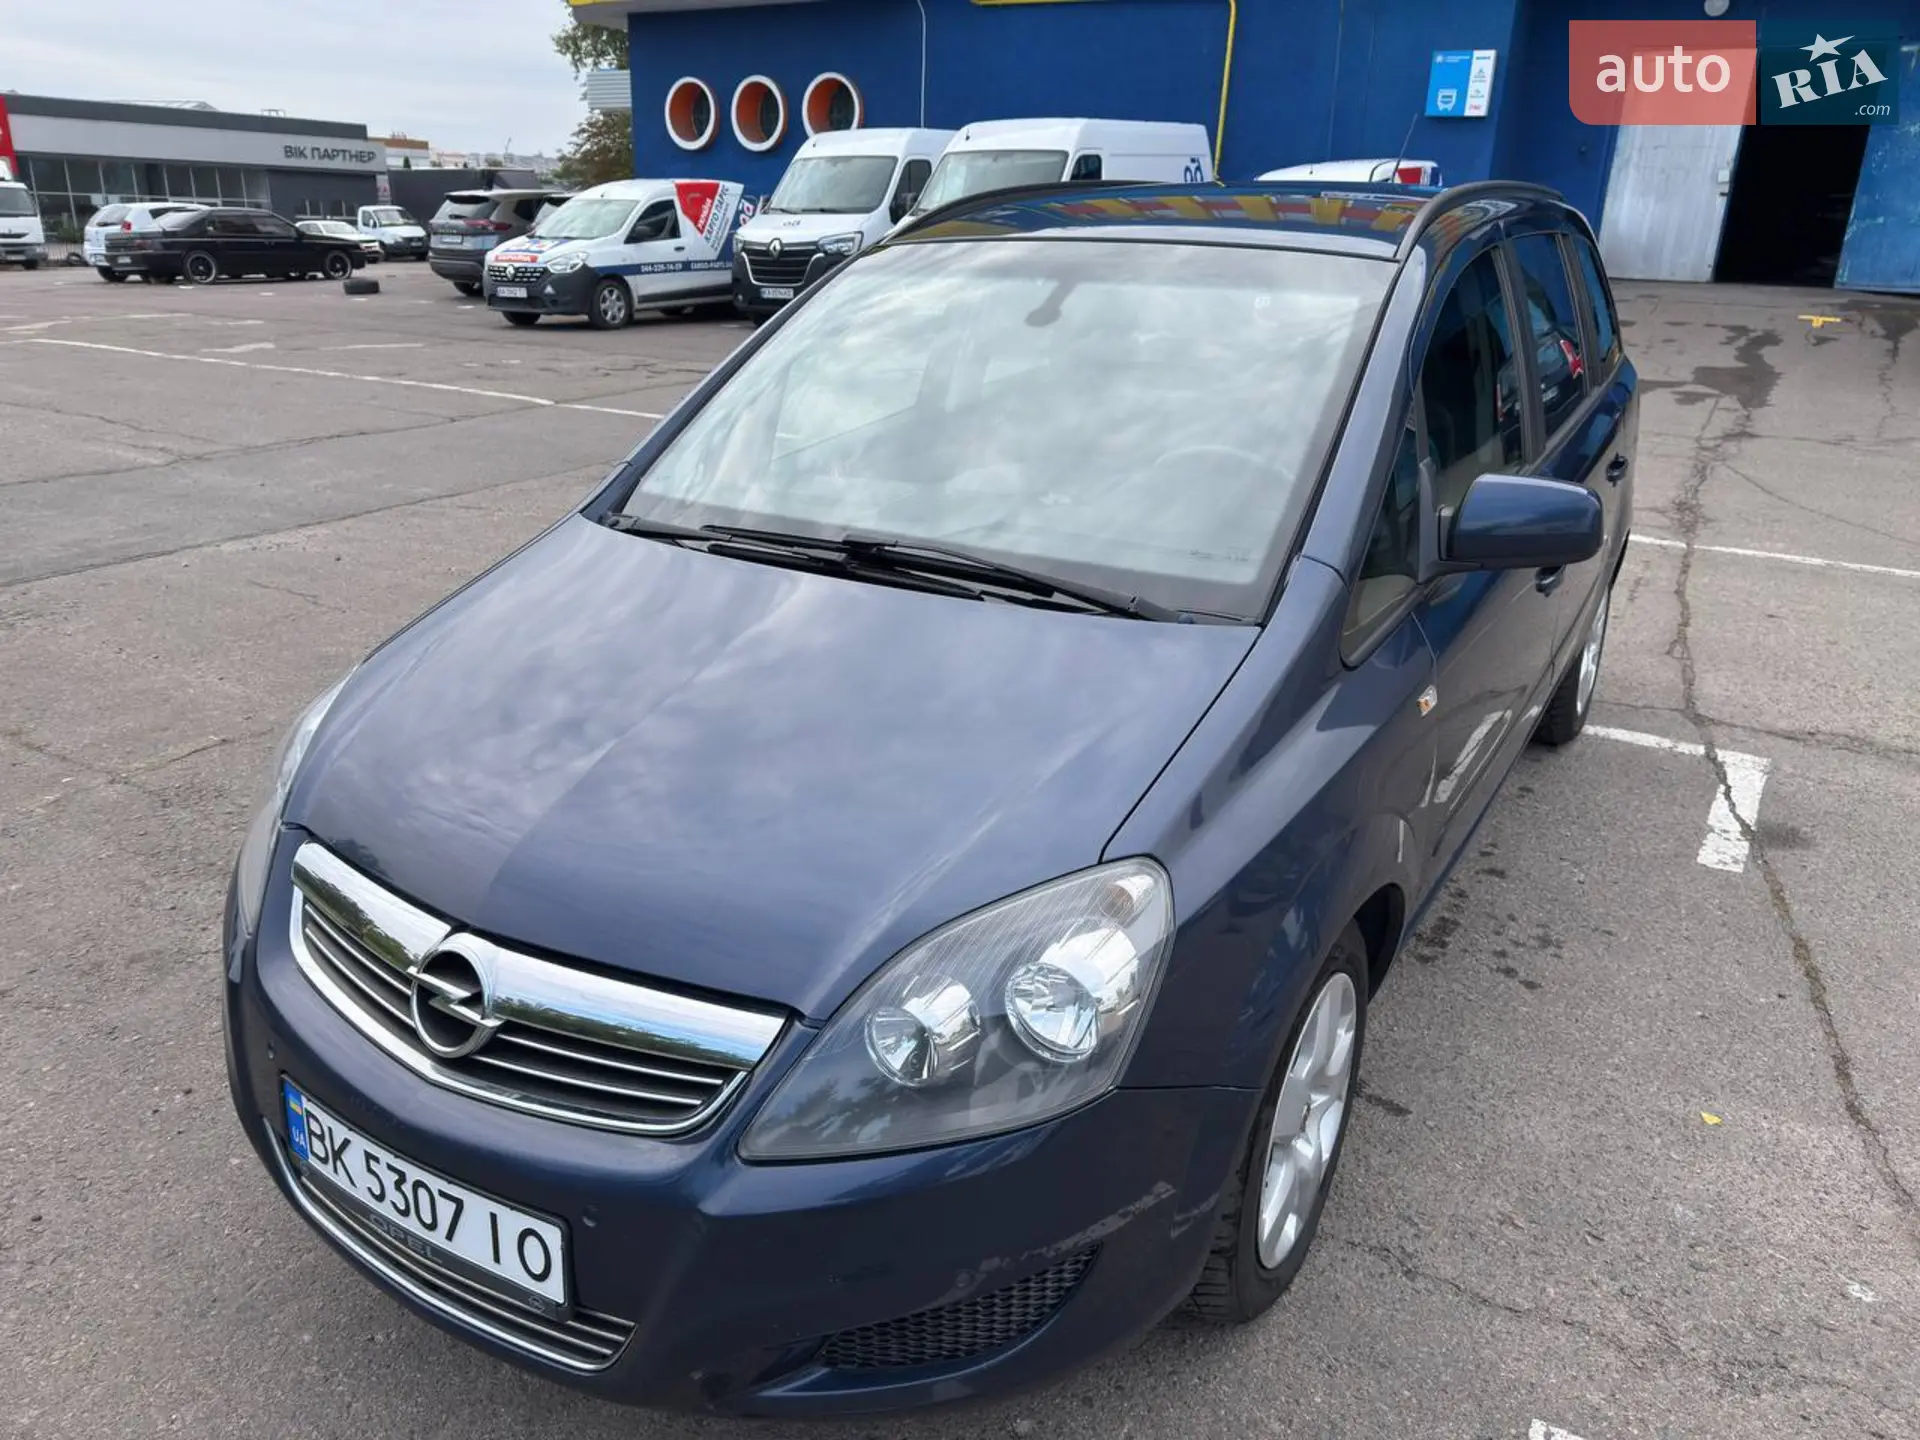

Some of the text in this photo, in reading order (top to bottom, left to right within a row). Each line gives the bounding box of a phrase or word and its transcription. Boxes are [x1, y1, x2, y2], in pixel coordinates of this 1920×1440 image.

[283, 144, 377, 164] ВІК ПАРТНЕР
[291, 1125, 305, 1148] UA
[304, 1107, 552, 1282] BK 5307 IO
[369, 1214, 442, 1264] OPEL
